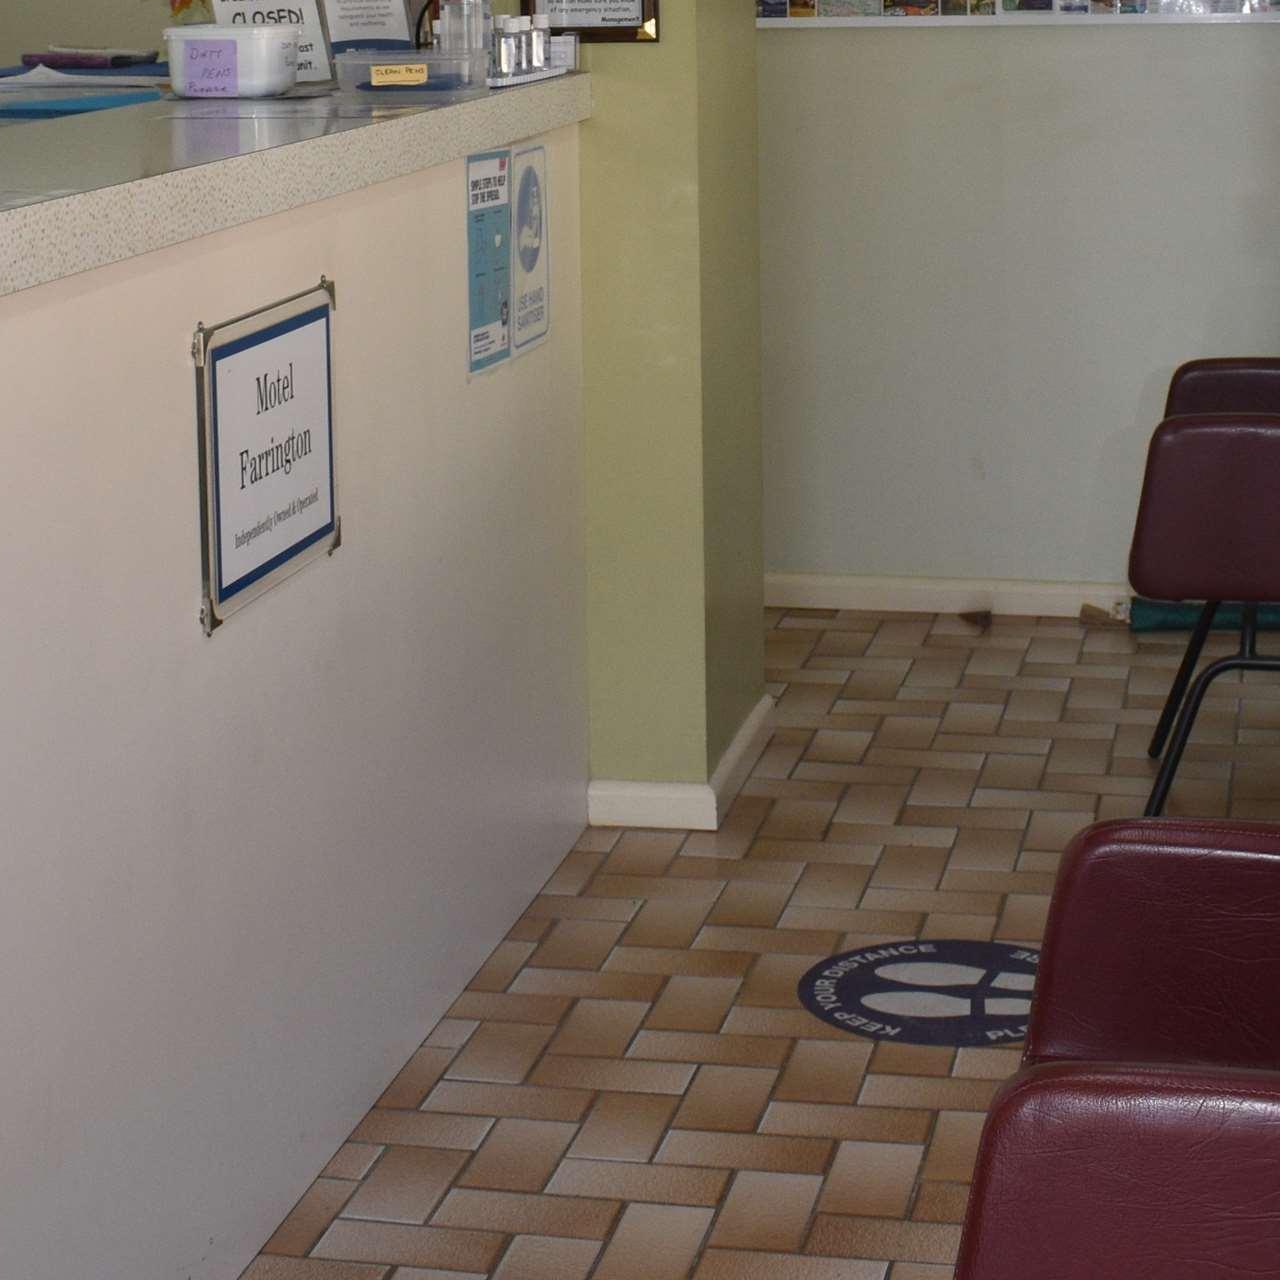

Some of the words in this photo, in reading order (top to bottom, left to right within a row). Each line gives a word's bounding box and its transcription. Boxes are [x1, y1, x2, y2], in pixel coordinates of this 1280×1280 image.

[256, 362, 295, 416] Motel
[239, 427, 312, 490] Farrington
[822, 944, 938, 978] DISTANCE
[814, 979, 843, 1010] YOUR
[834, 1012, 902, 1037] KEEP
